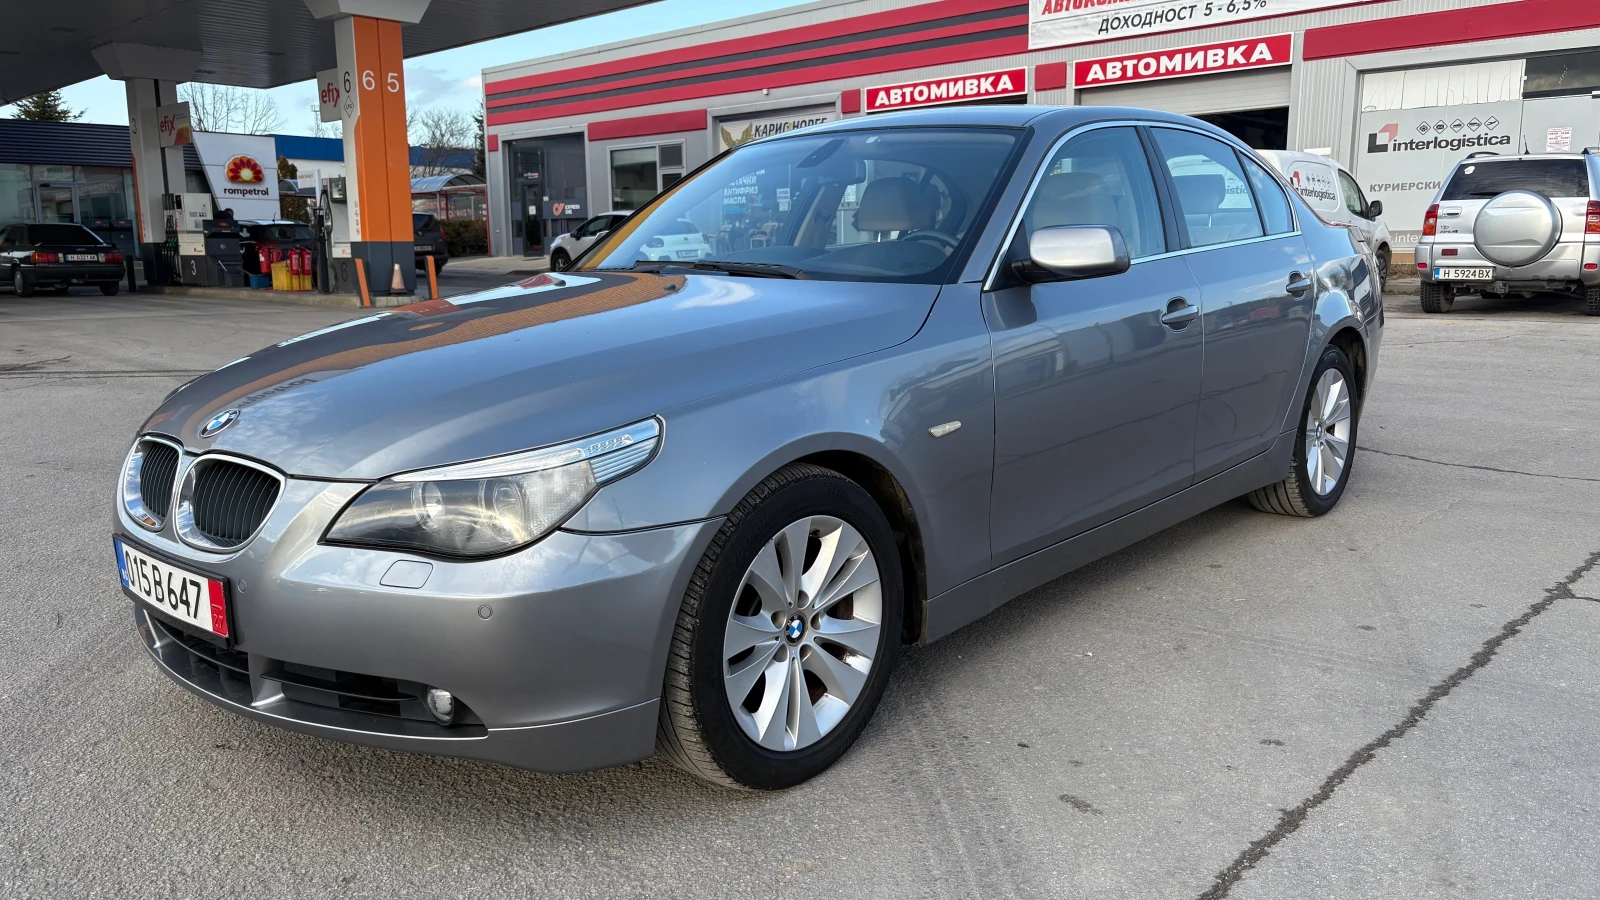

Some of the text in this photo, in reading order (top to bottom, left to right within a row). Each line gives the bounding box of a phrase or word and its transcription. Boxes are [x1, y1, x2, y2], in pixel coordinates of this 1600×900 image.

[1097, 5, 1198, 35] ДОХОДНОСТ
[1203, 2, 1214, 17] 5
[1086, 42, 1273, 82] АВТОМИВКА
[343, 71, 351, 93] 6
[362, 69, 400, 93] 6 5
[874, 74, 1014, 107] АВТОМИВКА
[131, 117, 137, 135] 3
[160, 114, 176, 136] efix
[1392, 133, 1511, 151] interlogistica
[223, 187, 269, 197] rompetrol
[723, 186, 759, 197] АНТИФРИЗ
[1299, 185, 1337, 201] interlogistica
[1369, 181, 1441, 192] КУРИЕРСКИ
[723, 196, 746, 205] МАСЛА
[190, 260, 197, 276] 3
